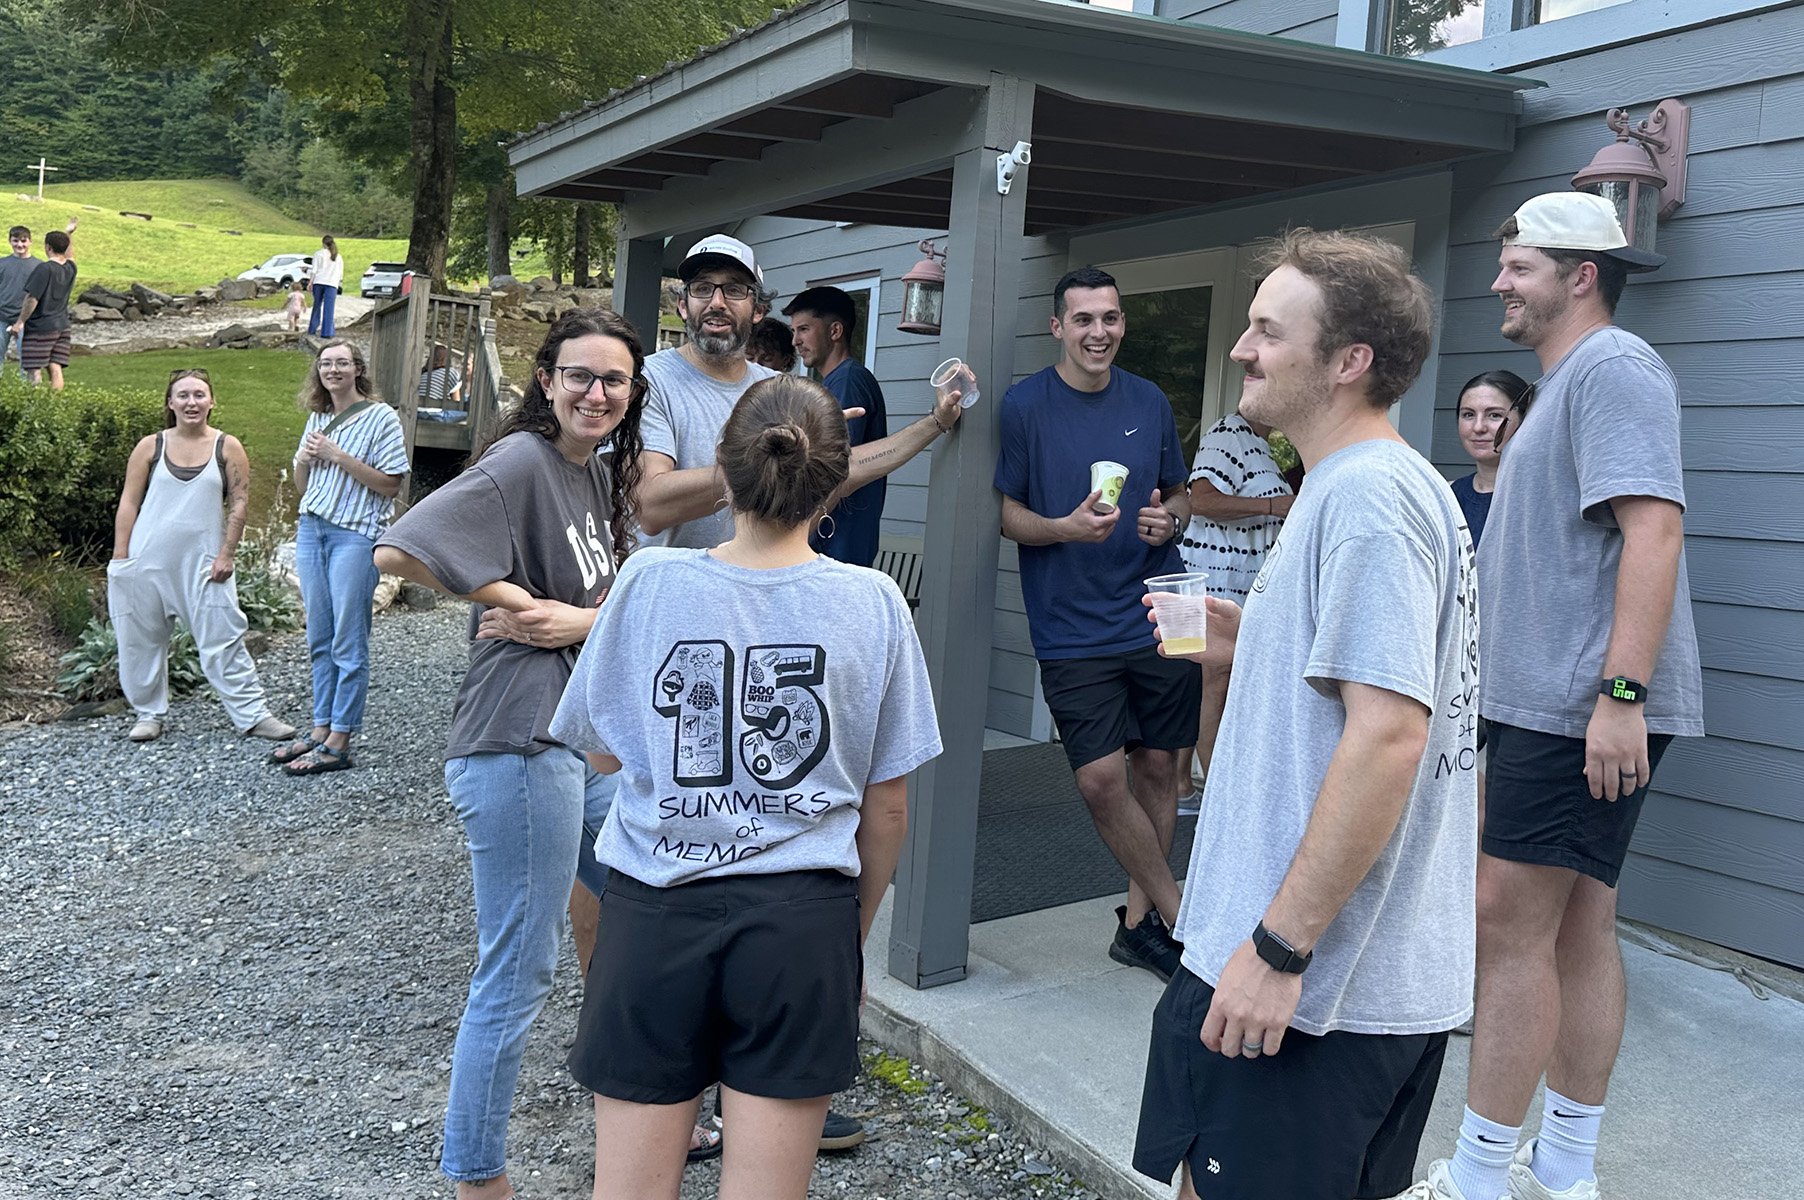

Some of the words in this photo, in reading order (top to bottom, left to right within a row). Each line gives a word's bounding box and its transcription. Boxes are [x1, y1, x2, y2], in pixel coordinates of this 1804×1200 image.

[747, 694, 775, 703] WHIP
[748, 685, 775, 696] BOO
[652, 639, 831, 791] 15
[658, 789, 831, 820] SUMMERS
[735, 816, 764, 839] of
[652, 835, 783, 863] MEMO
